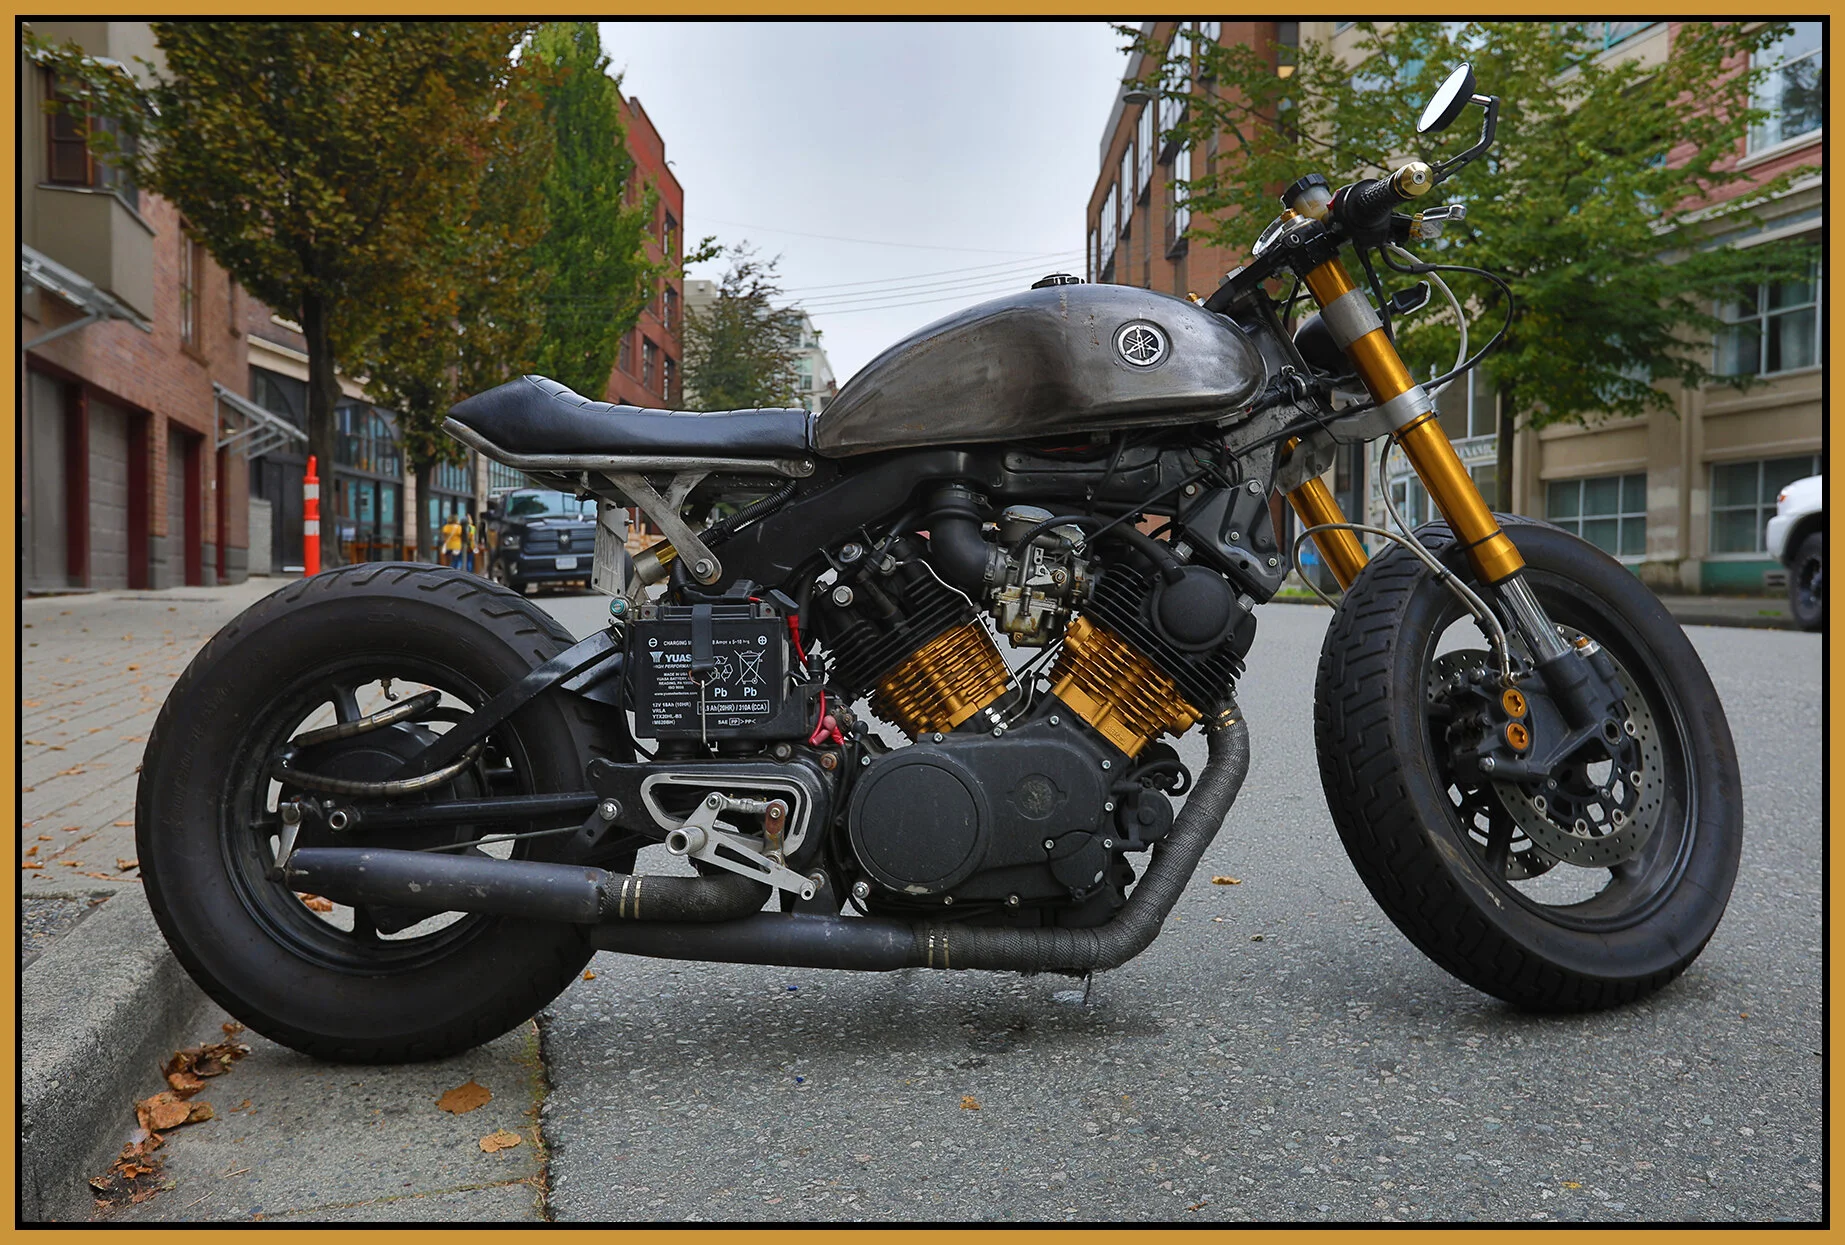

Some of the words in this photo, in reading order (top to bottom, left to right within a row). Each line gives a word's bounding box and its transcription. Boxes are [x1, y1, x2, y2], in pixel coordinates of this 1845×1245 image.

[665, 653, 692, 663] YUAS
[714, 687, 728, 697] Pb
[744, 687, 757, 697] Pb
